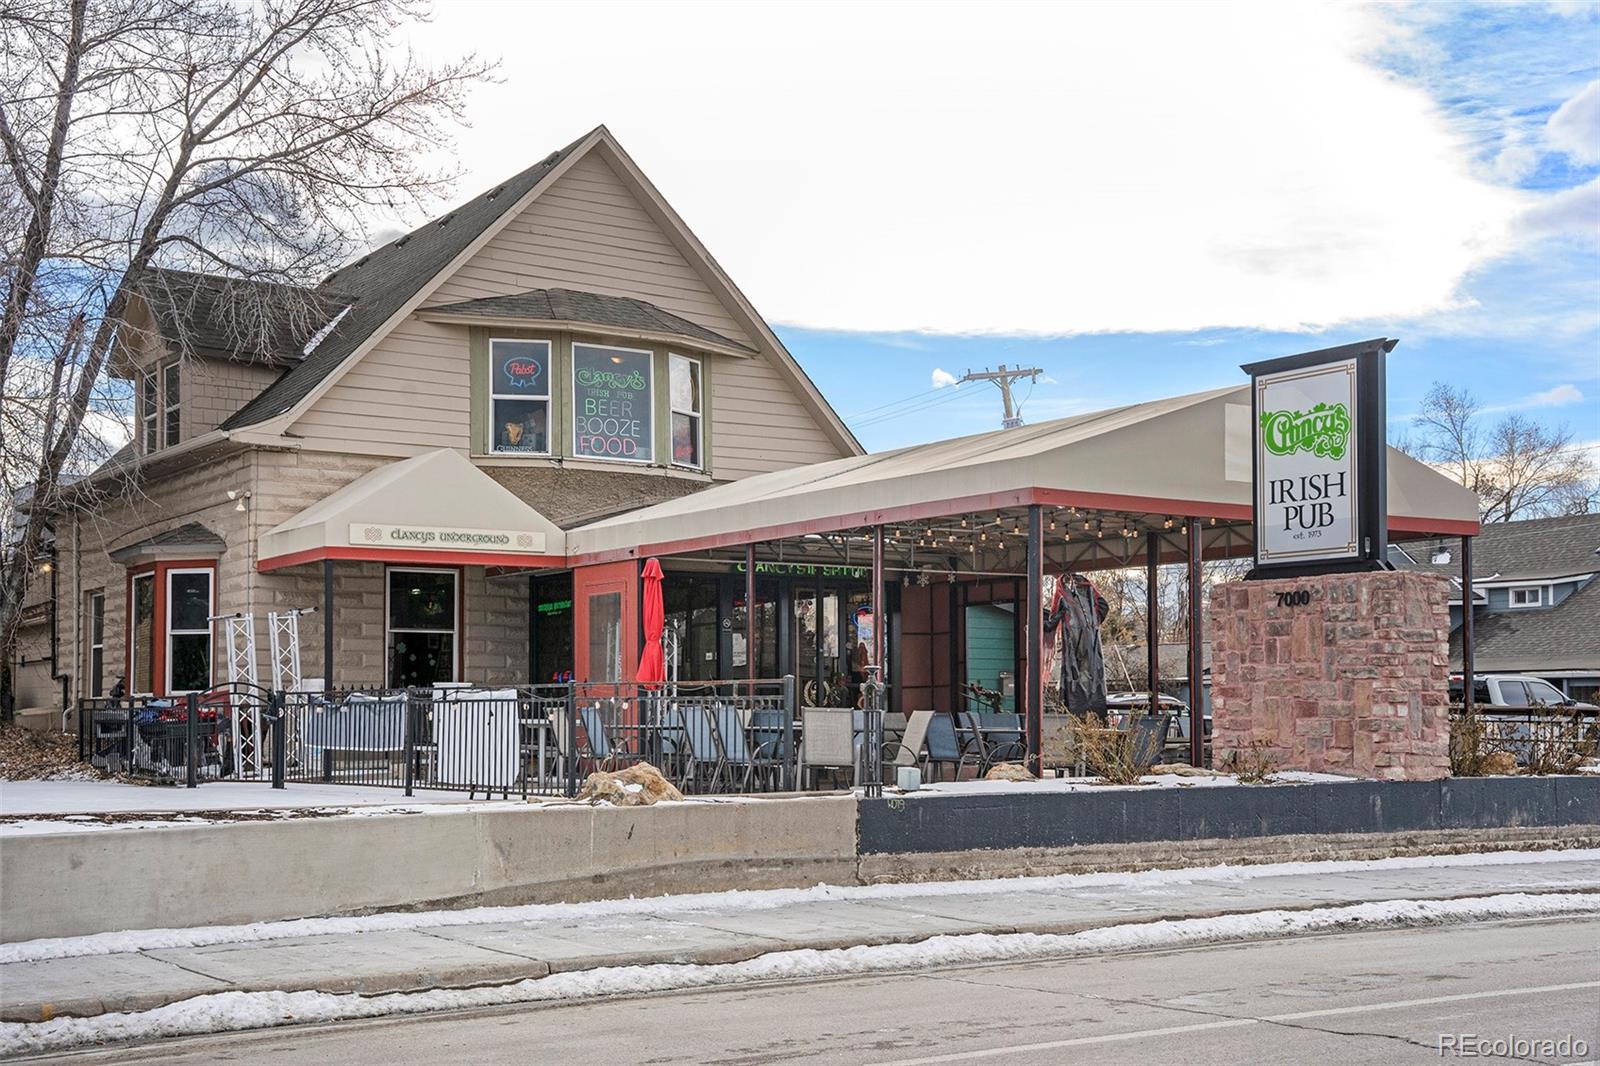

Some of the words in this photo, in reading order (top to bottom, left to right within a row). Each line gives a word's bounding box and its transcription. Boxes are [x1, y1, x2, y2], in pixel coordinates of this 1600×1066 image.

[585, 398, 633, 417] BEER
[576, 416, 641, 437] BOOZE
[580, 435, 637, 455] FOOD
[1269, 471, 1347, 505] IRISH
[1283, 502, 1335, 531] PUB
[1308, 530, 1322, 539] 1973
[1275, 590, 1310, 607] 7000
